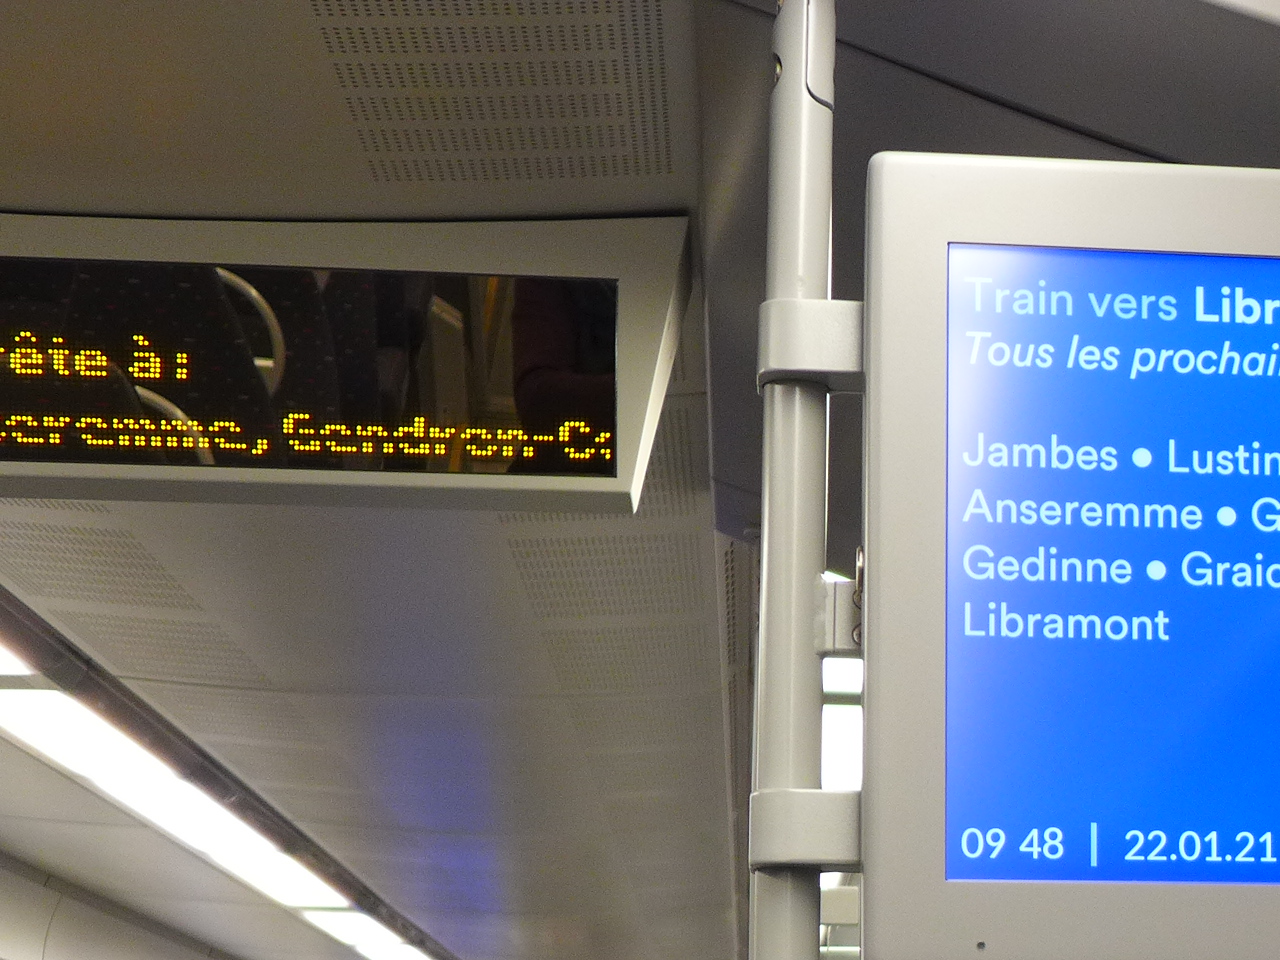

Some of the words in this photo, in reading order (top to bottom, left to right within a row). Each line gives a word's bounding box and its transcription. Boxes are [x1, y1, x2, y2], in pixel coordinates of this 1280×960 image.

[964, 277, 1073, 316] Train
[1088, 293, 1177, 321] vers
[0, 331, 108, 376] ête
[965, 331, 1055, 368] Tous
[1067, 334, 1120, 371] les
[963, 433, 1118, 471] Jambes
[963, 489, 1203, 530] Anseremme
[963, 545, 1132, 584] Gedinne
[965, 602, 1169, 641] Libramont
[961, 828, 1006, 859] 09
[1019, 827, 1064, 859] 48
[1125, 830, 1277, 862] 22.01.21
